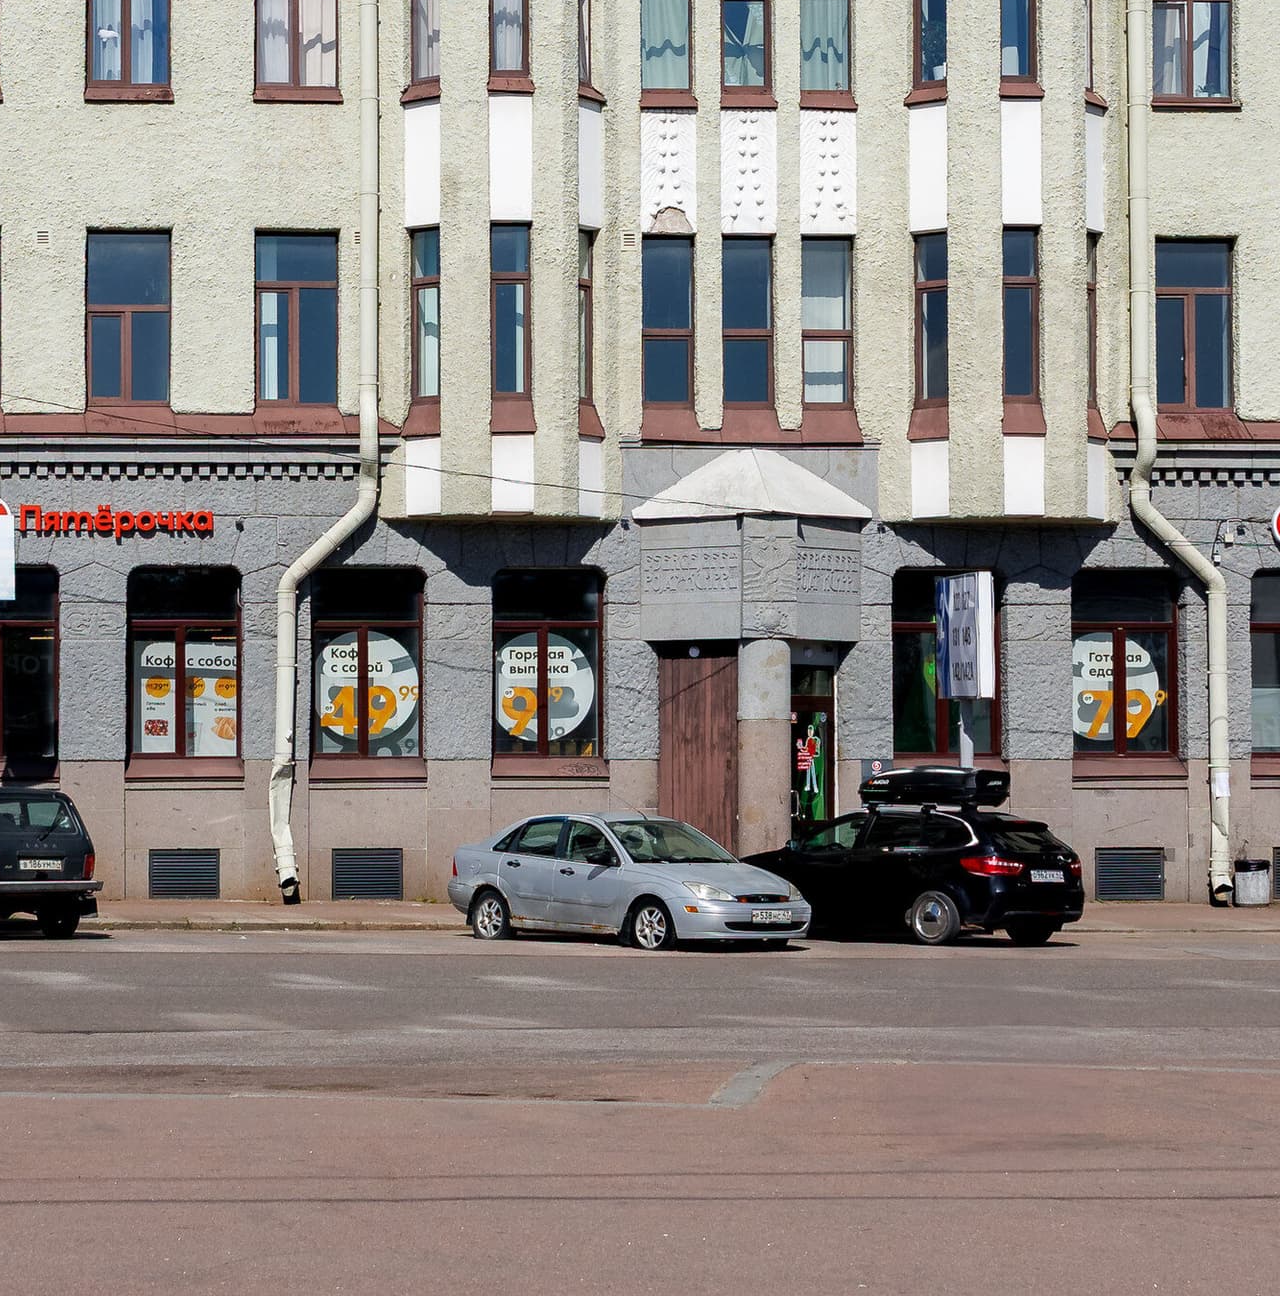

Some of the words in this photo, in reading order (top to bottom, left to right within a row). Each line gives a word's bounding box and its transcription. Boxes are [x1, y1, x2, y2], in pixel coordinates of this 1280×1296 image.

[19, 504, 214, 539] Пятёрочка
[330, 647, 358, 661] Коф
[509, 649, 564, 662] Горяая
[1088, 652, 1142, 663] Готая
[145, 655, 175, 669] Коф
[187, 657, 194, 666] с
[330, 664, 338, 673] с
[342, 661, 383, 673] соой
[509, 665, 569, 674] выпка
[501, 686, 538, 736] 9
[1080, 689, 1153, 738] 79
